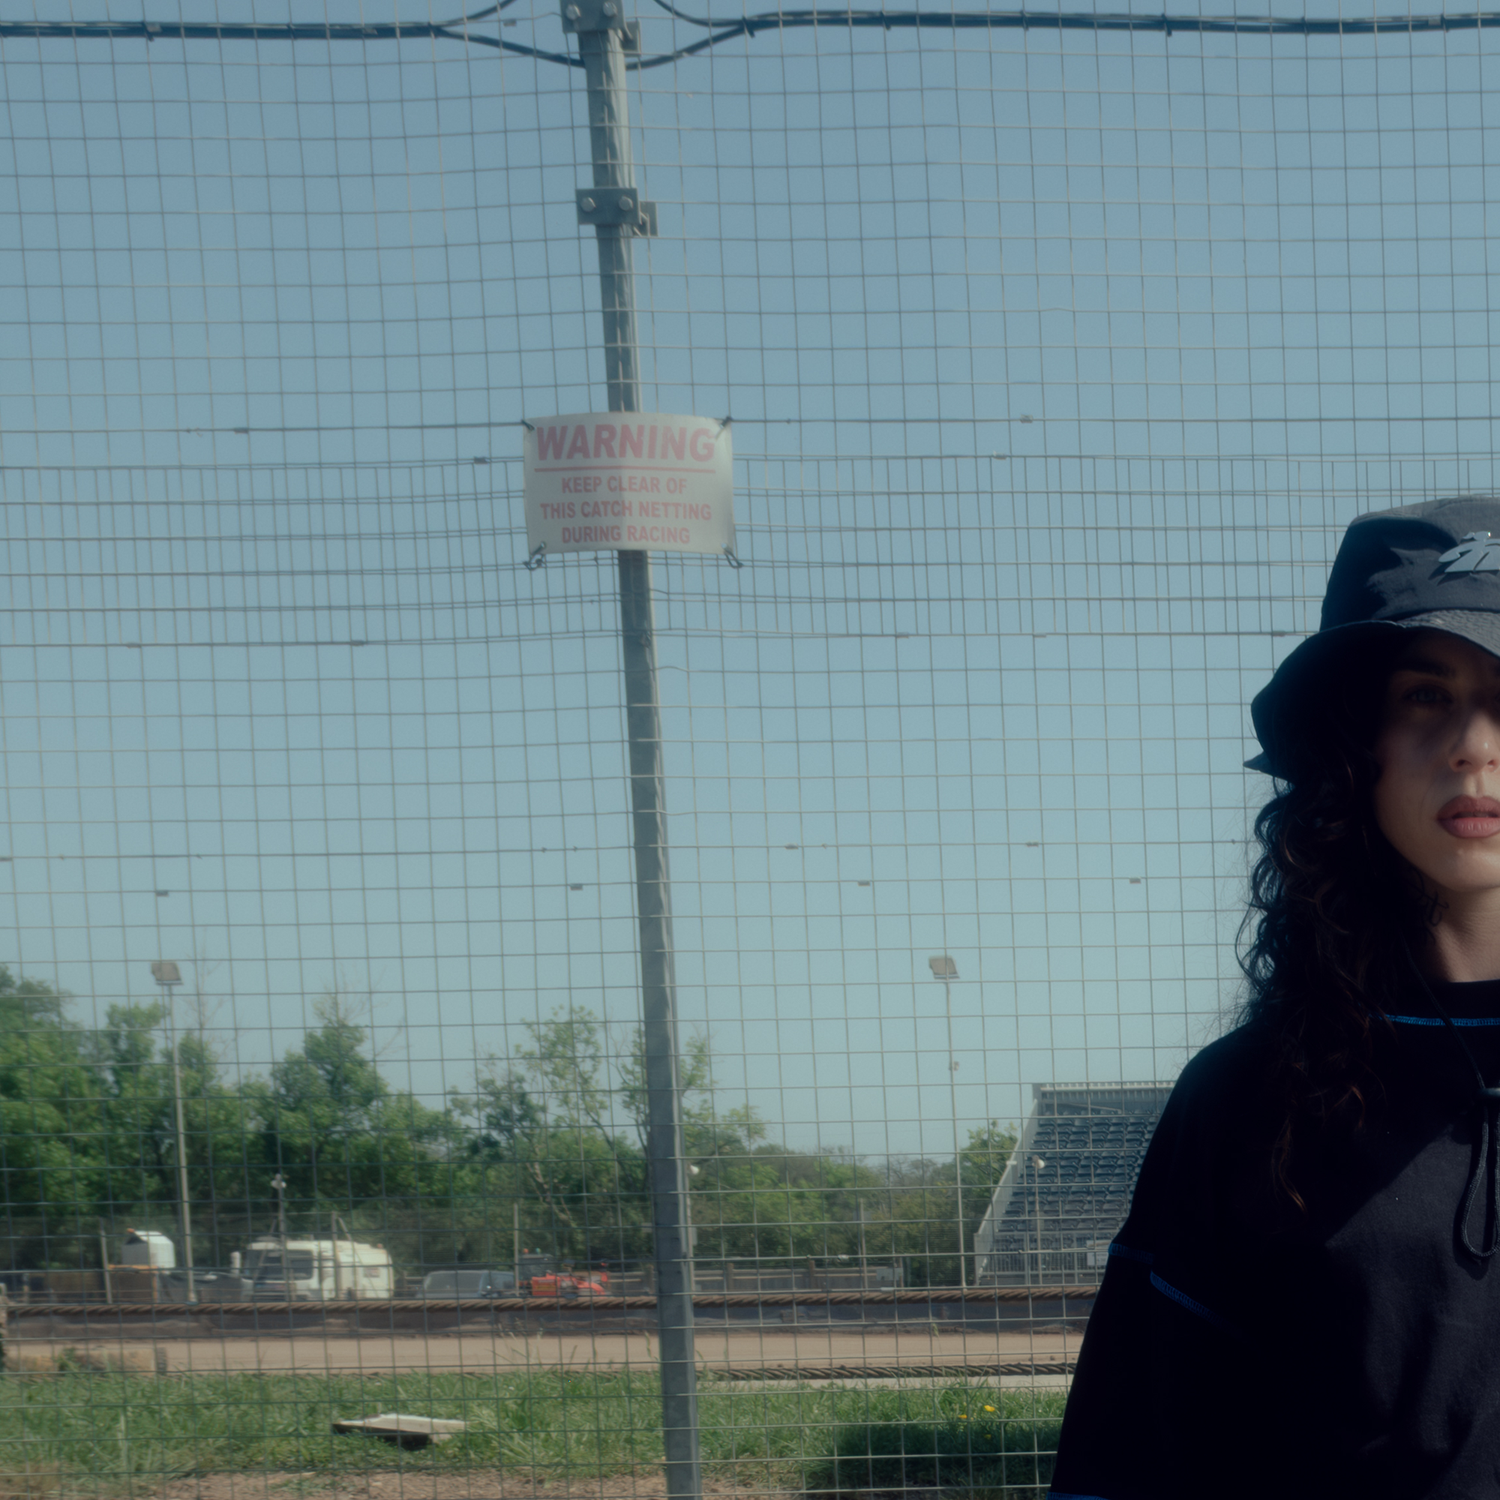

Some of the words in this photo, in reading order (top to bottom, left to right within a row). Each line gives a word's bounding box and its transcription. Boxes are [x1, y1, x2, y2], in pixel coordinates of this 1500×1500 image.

[536, 424, 715, 462] WARNING
[561, 476, 602, 494] KEEP
[606, 475, 661, 494] CLEAR
[666, 477, 687, 494] OF
[540, 501, 576, 520] THIS
[580, 499, 633, 518] CATCH
[638, 501, 712, 521] NETTING
[561, 525, 622, 544] DURING
[627, 525, 690, 544] RACING
